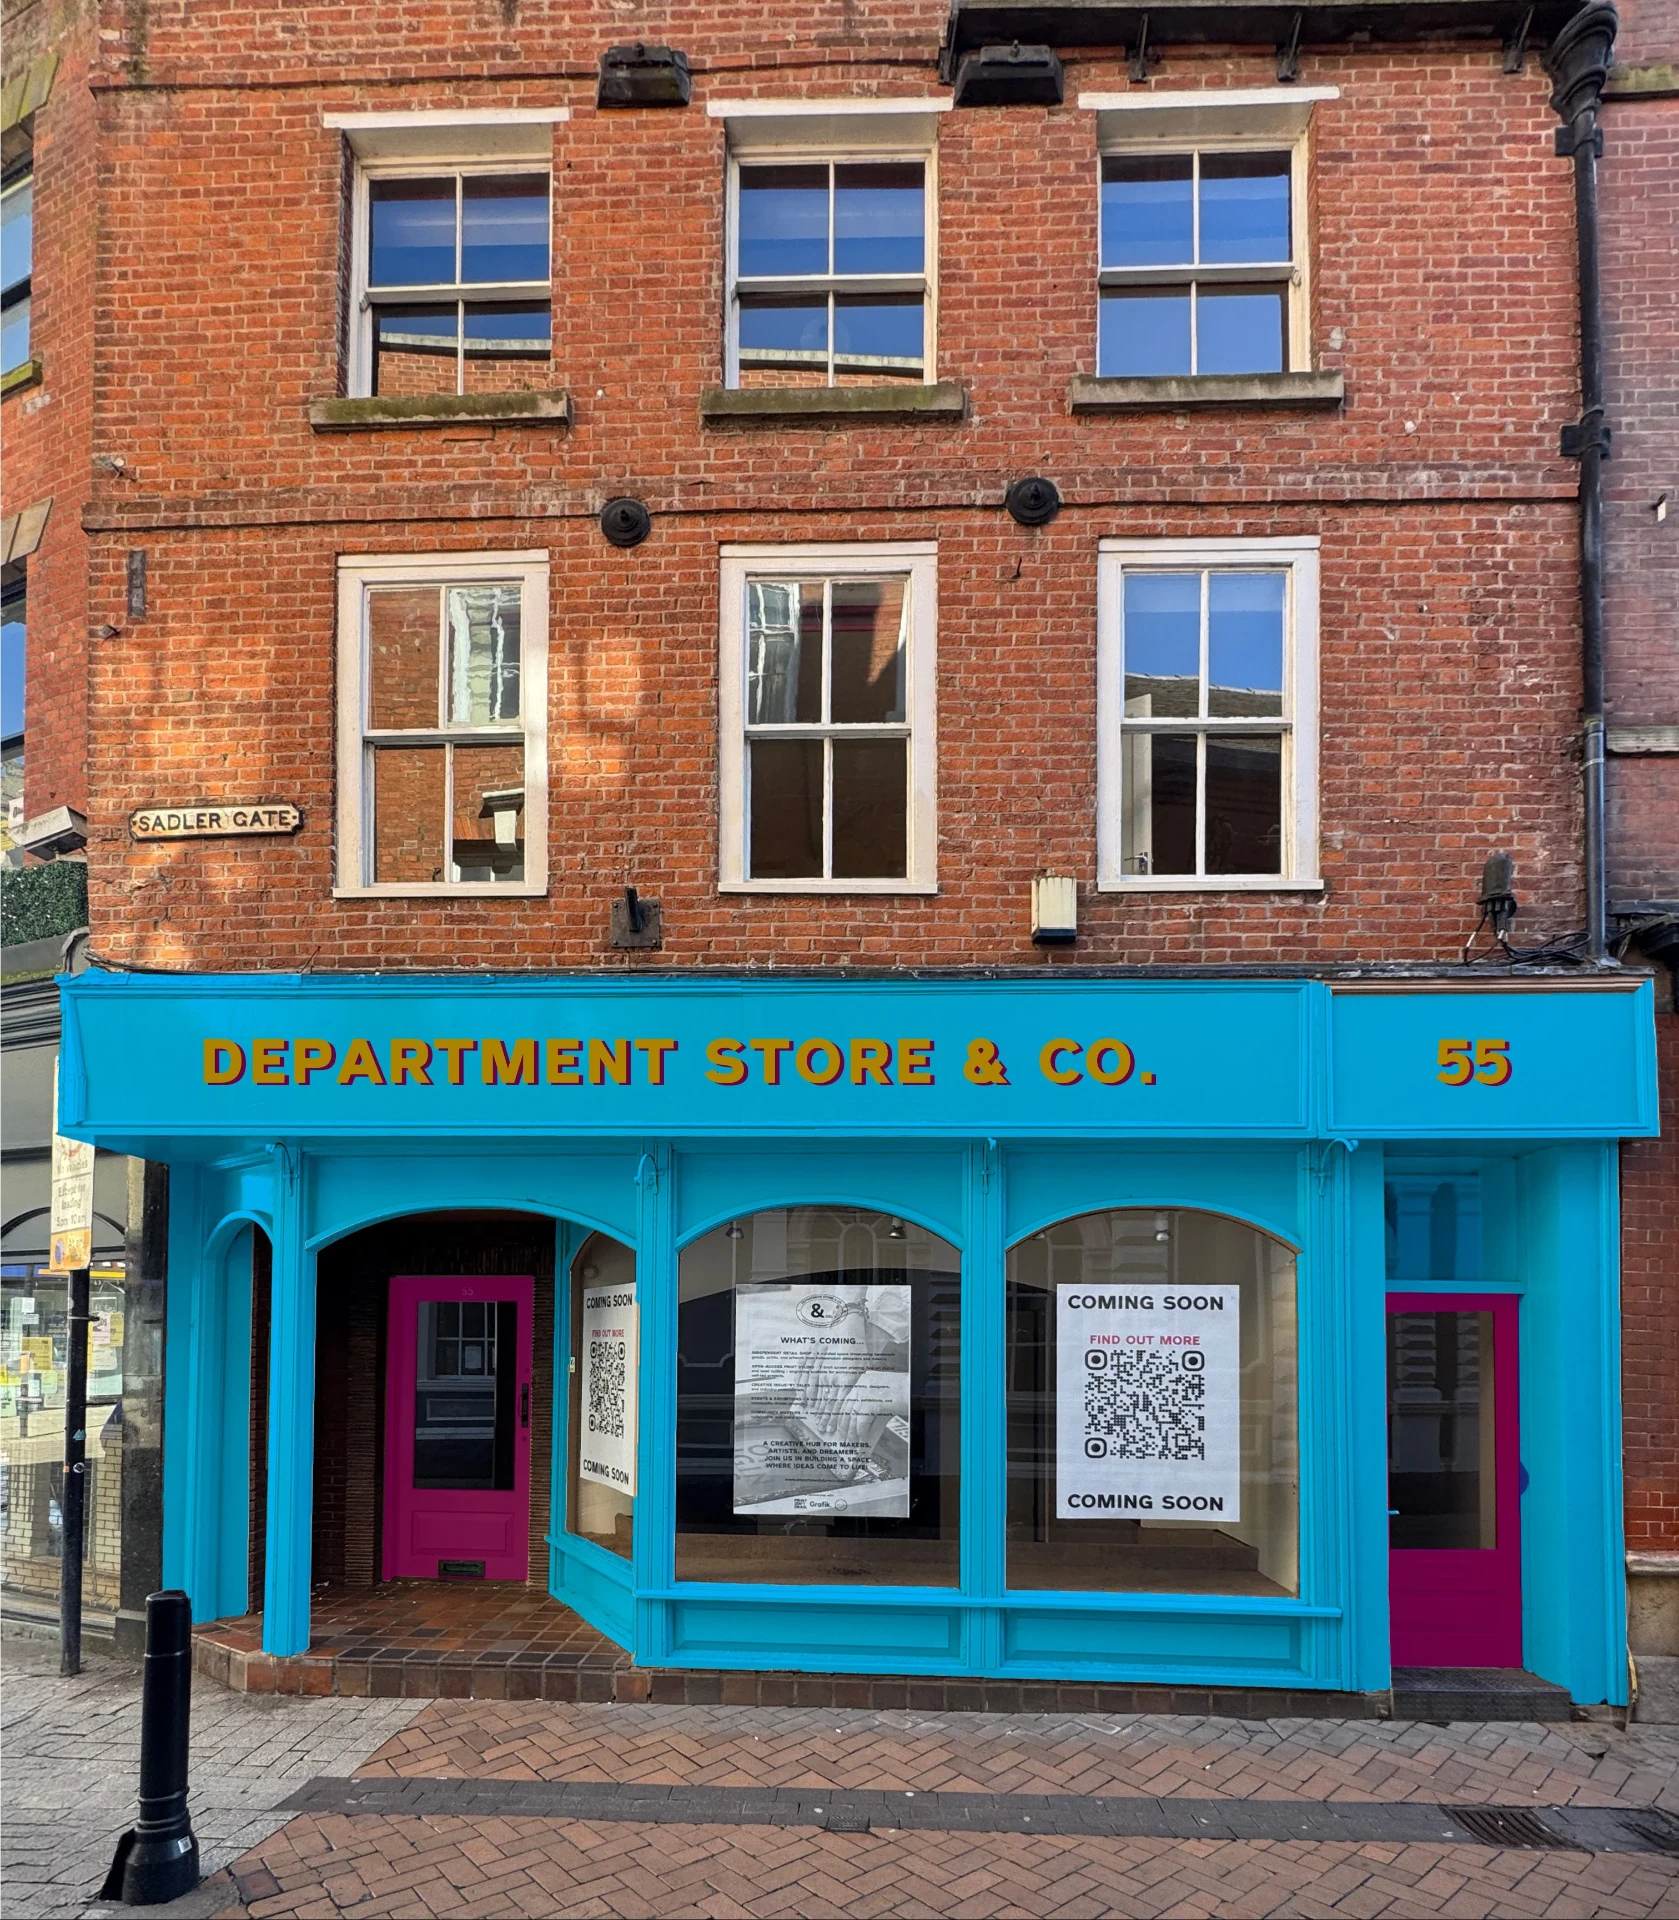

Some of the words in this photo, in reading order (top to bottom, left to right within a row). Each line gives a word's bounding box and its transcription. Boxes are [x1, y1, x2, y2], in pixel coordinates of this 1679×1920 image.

[138, 812, 222, 832] SADLER
[232, 810, 291, 827] GATE
[203, 1038, 679, 1085] DEPARTMENT
[704, 1038, 935, 1085] STORE
[963, 1038, 1011, 1085] &
[1039, 1038, 1156, 1085] CO.
[1436, 1039, 1512, 1086] 55
[461, 1286, 474, 1296] 55
[586, 1295, 612, 1309] COMING
[612, 1292, 633, 1307] SOON
[1068, 1295, 1154, 1310] COMING
[1162, 1296, 1224, 1310] SOON
[810, 1303, 824, 1318] &
[592, 1330, 601, 1338] FIND
[612, 1329, 624, 1337] MORE
[780, 1336, 816, 1344] WHAT'S
[819, 1337, 864, 1345] COMING...
[1090, 1335, 1120, 1345] FIND
[1126, 1335, 1154, 1345] OUT
[1160, 1336, 1201, 1346] MORE
[583, 1458, 610, 1478] COMING
[612, 1468, 629, 1485] SOON
[1068, 1494, 1153, 1509] COMING
[1162, 1496, 1224, 1512] SOON
